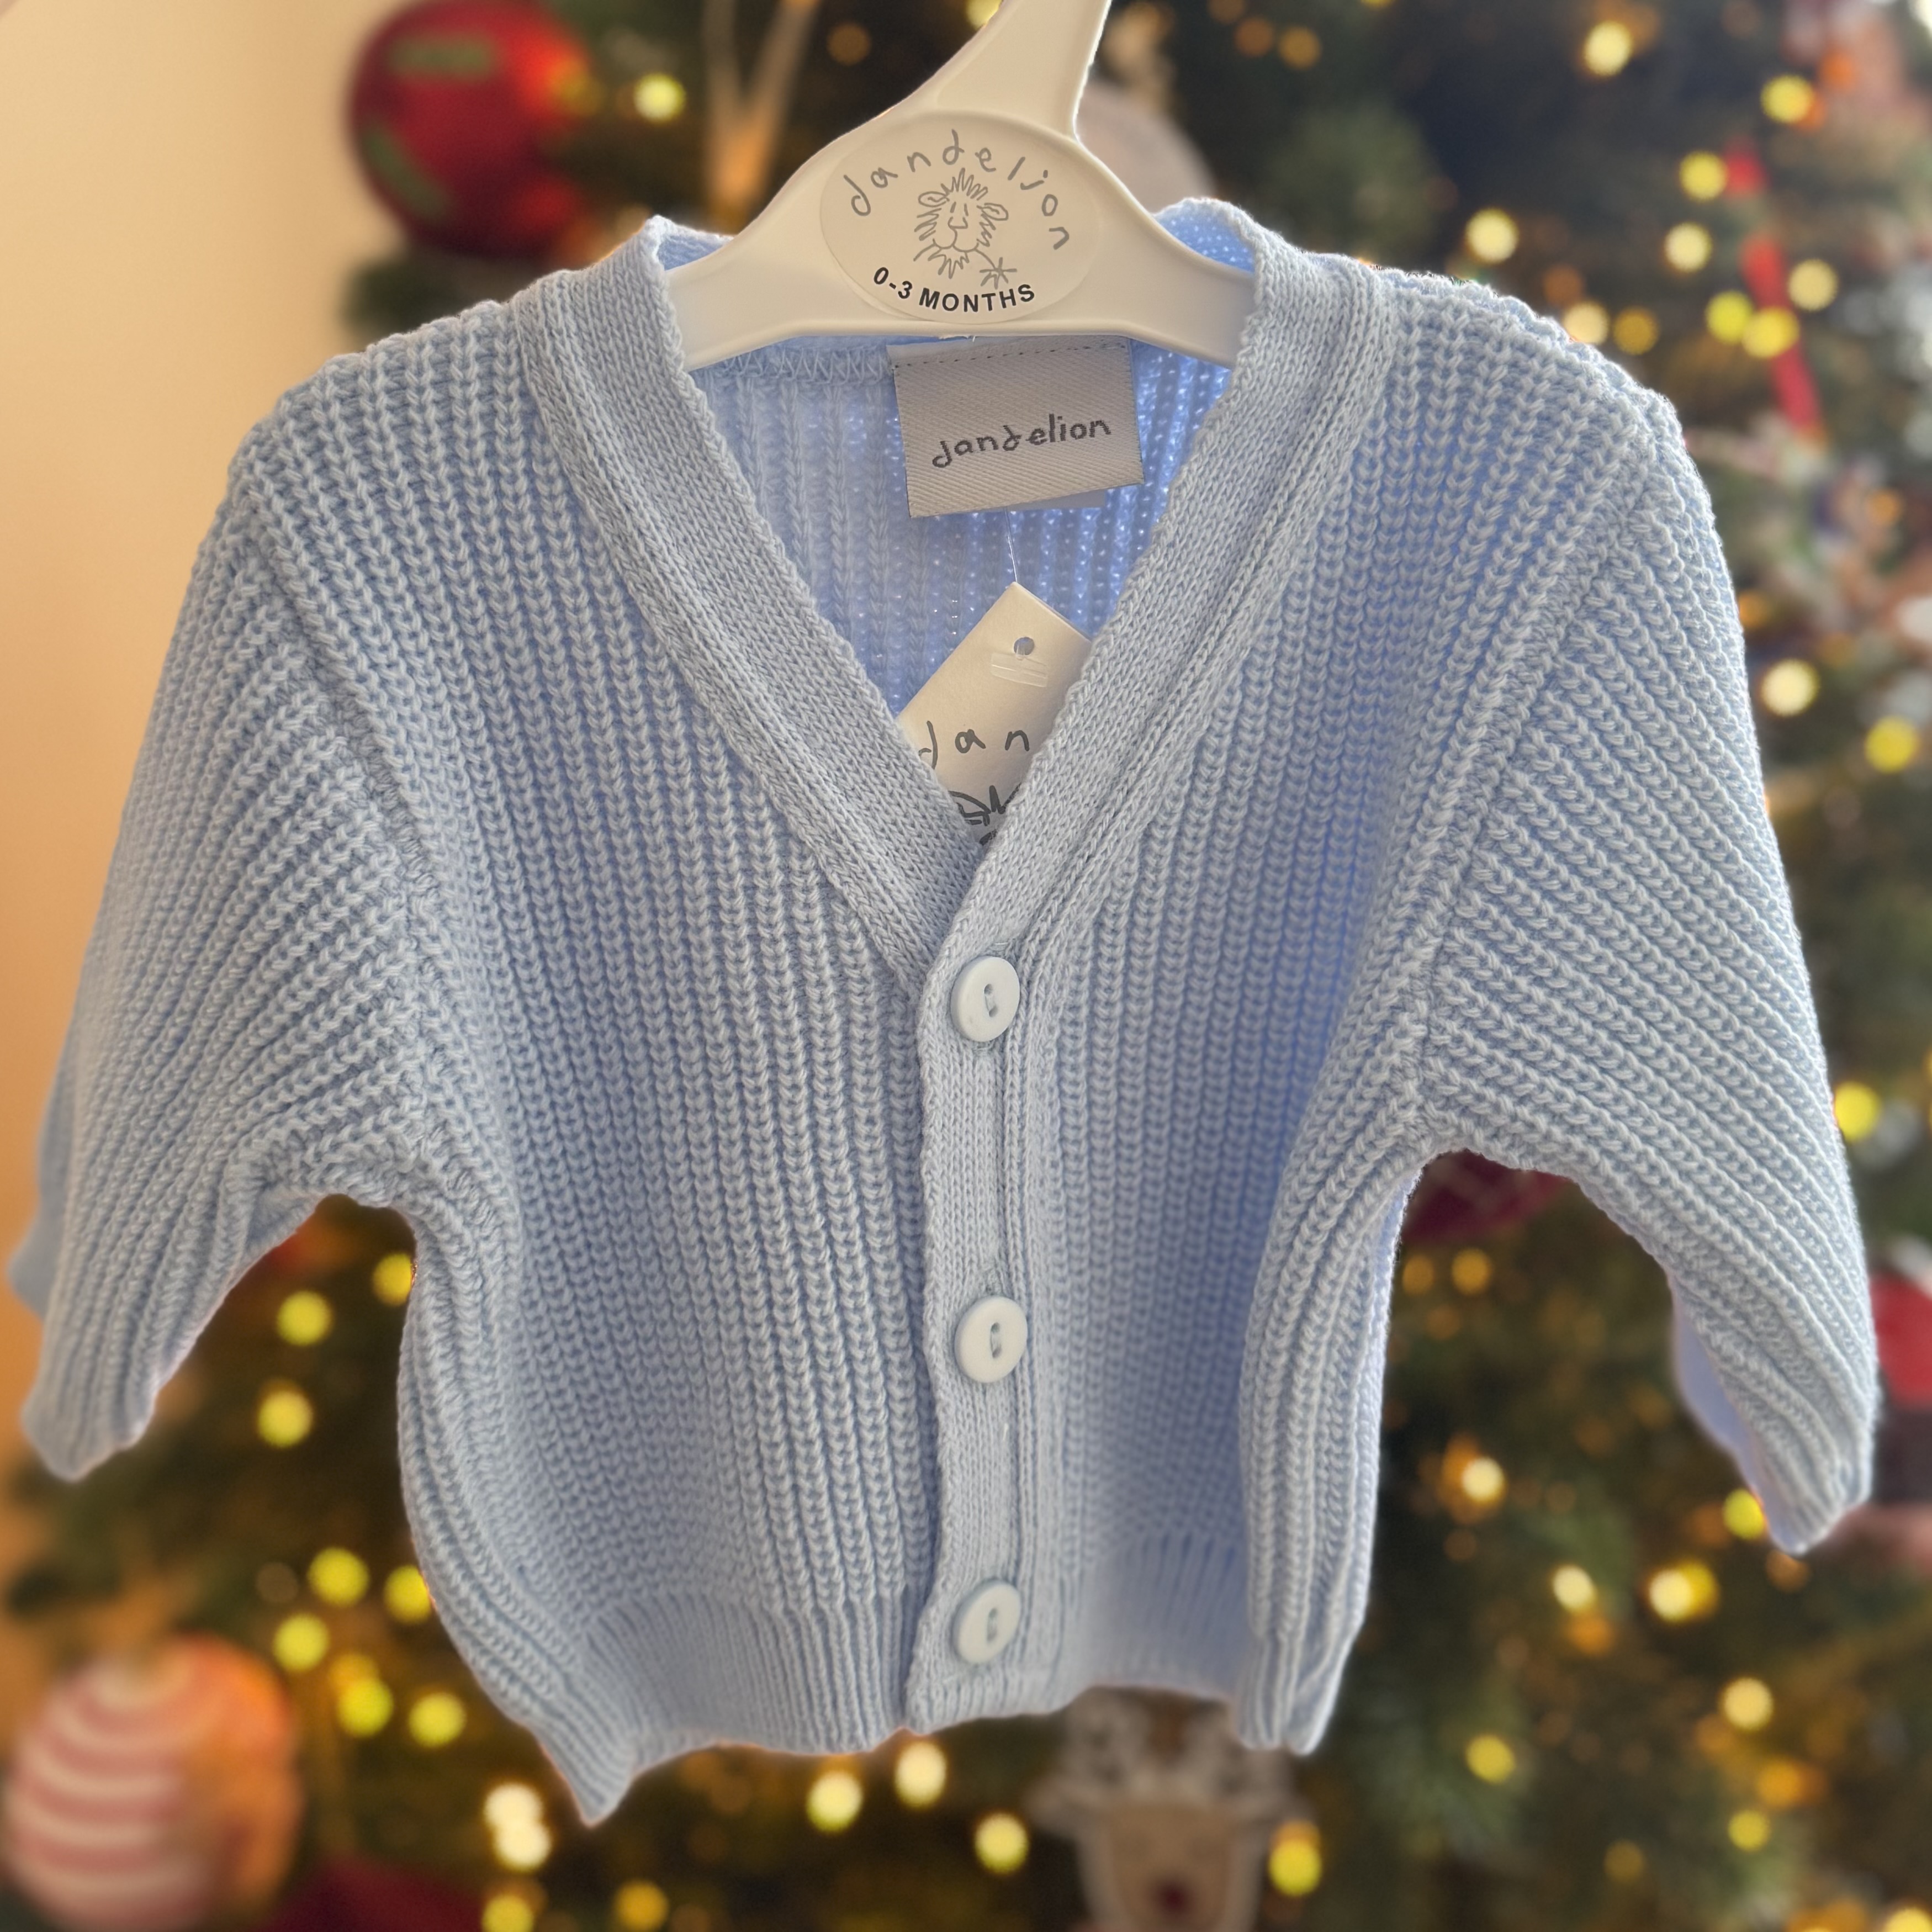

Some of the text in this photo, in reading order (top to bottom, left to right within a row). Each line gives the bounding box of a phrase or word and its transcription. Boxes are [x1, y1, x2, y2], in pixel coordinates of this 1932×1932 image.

[843, 129, 1070, 250] dandelion
[873, 267, 1035, 313] 0-3 MONTHS
[932, 414, 1111, 468] dandelion
